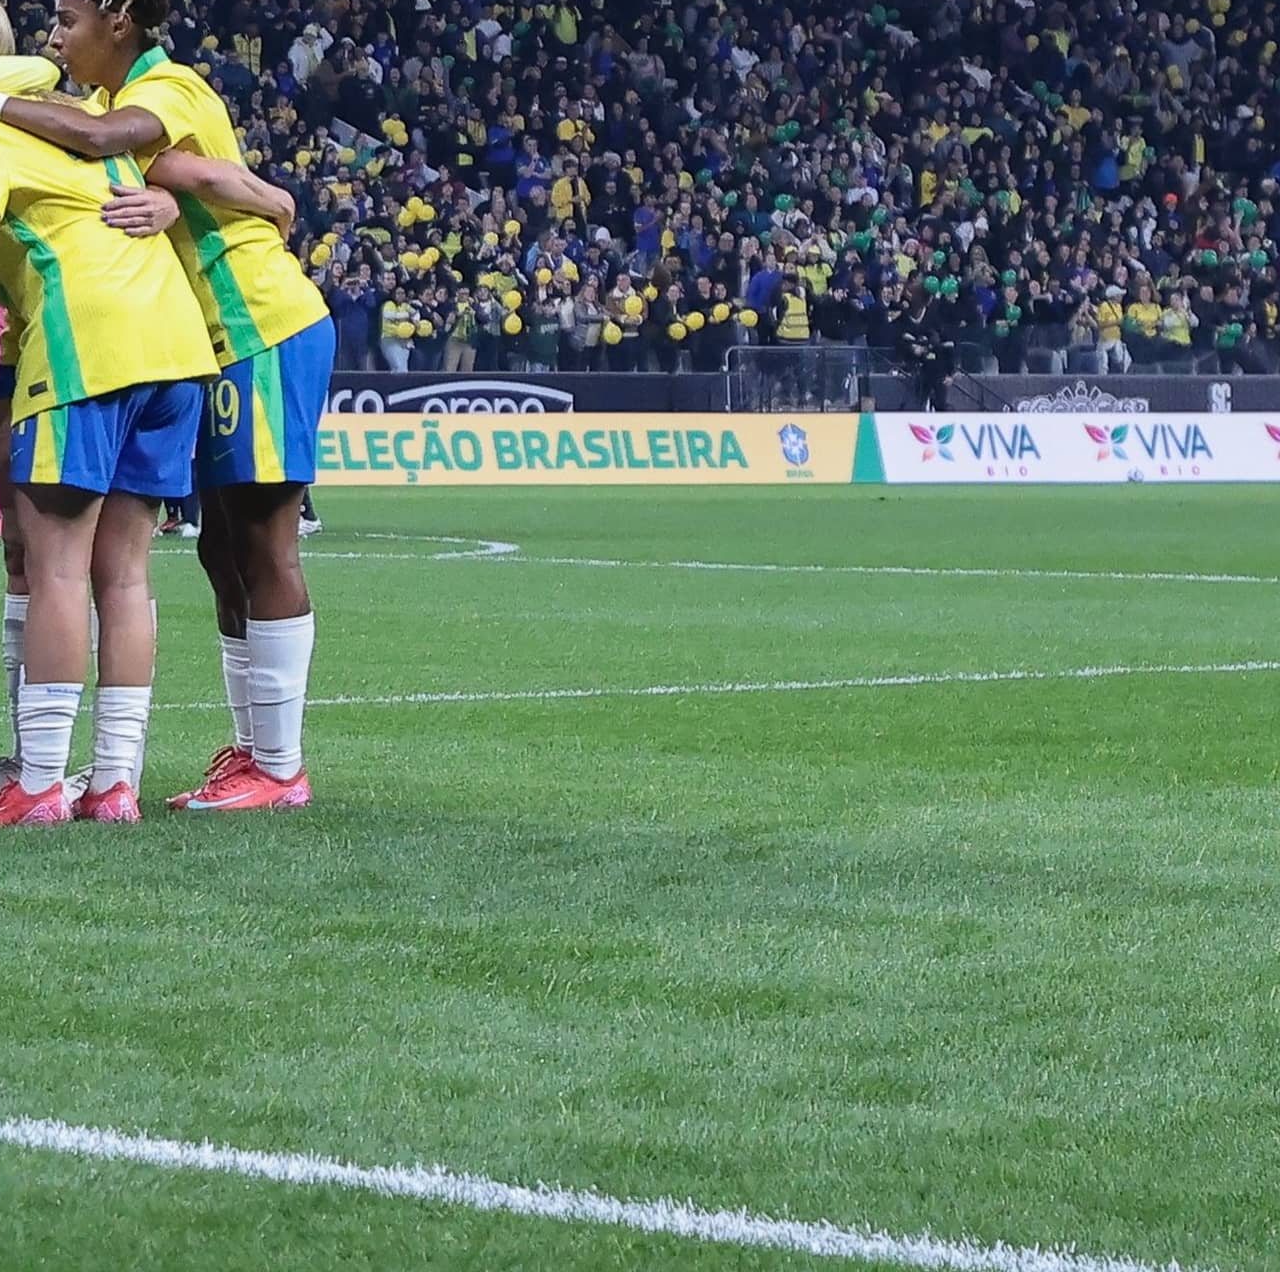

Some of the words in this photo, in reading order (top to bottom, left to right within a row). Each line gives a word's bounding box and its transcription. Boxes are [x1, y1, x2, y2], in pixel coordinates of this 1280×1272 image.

[208, 379, 240, 437] 19
[315, 420, 483, 483] ELEÇÃO
[492, 429, 749, 470] BRASILEIRA
[960, 423, 1042, 460] VIVA
[1135, 423, 1214, 460] VIVA
